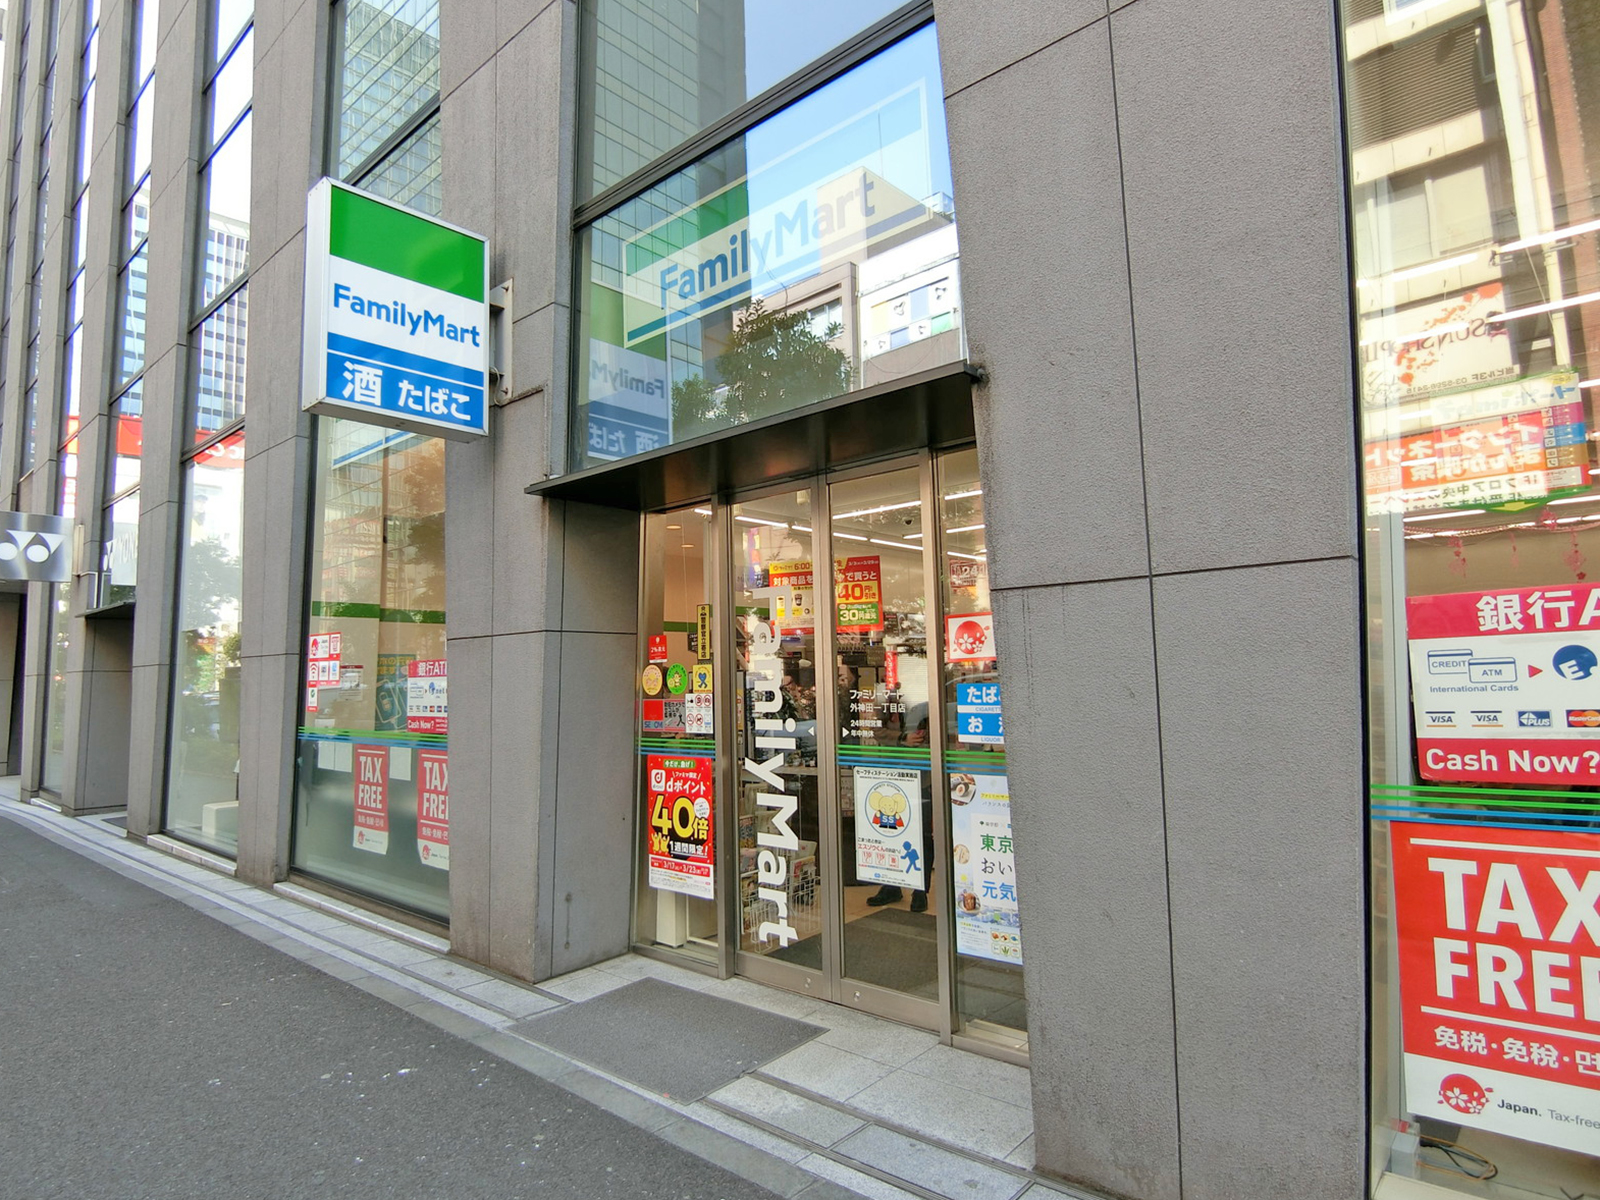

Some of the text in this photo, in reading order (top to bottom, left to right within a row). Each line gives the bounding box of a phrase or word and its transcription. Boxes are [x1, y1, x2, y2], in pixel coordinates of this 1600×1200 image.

[659, 172, 875, 309] FamilyMart
[333, 283, 480, 347] FamilyMart
[342, 361, 471, 421] 酒 たばこ
[1431, 660, 1467, 668] CREDIT
[1481, 669, 1503, 677] ATM
[849, 689, 904, 700] ファミリーマート
[967, 686, 1001, 703] たば
[1429, 684, 1520, 694] International Cards
[849, 702, 906, 713] 外神田一丁目店
[1430, 715, 1453, 723] VISA
[1475, 714, 1499, 722] VISA
[1529, 718, 1550, 727] PLUS
[360, 756, 383, 783] TAX
[745, 585, 798, 947] FamilyMart
[1426, 748, 1600, 774] Cash Now?
[666, 777, 706, 795] dポイント
[358, 784, 383, 809] FREE
[981, 857, 1013, 874] おい
[982, 880, 1016, 902] 元気
[1497, 1098, 1542, 1117] Japan.
